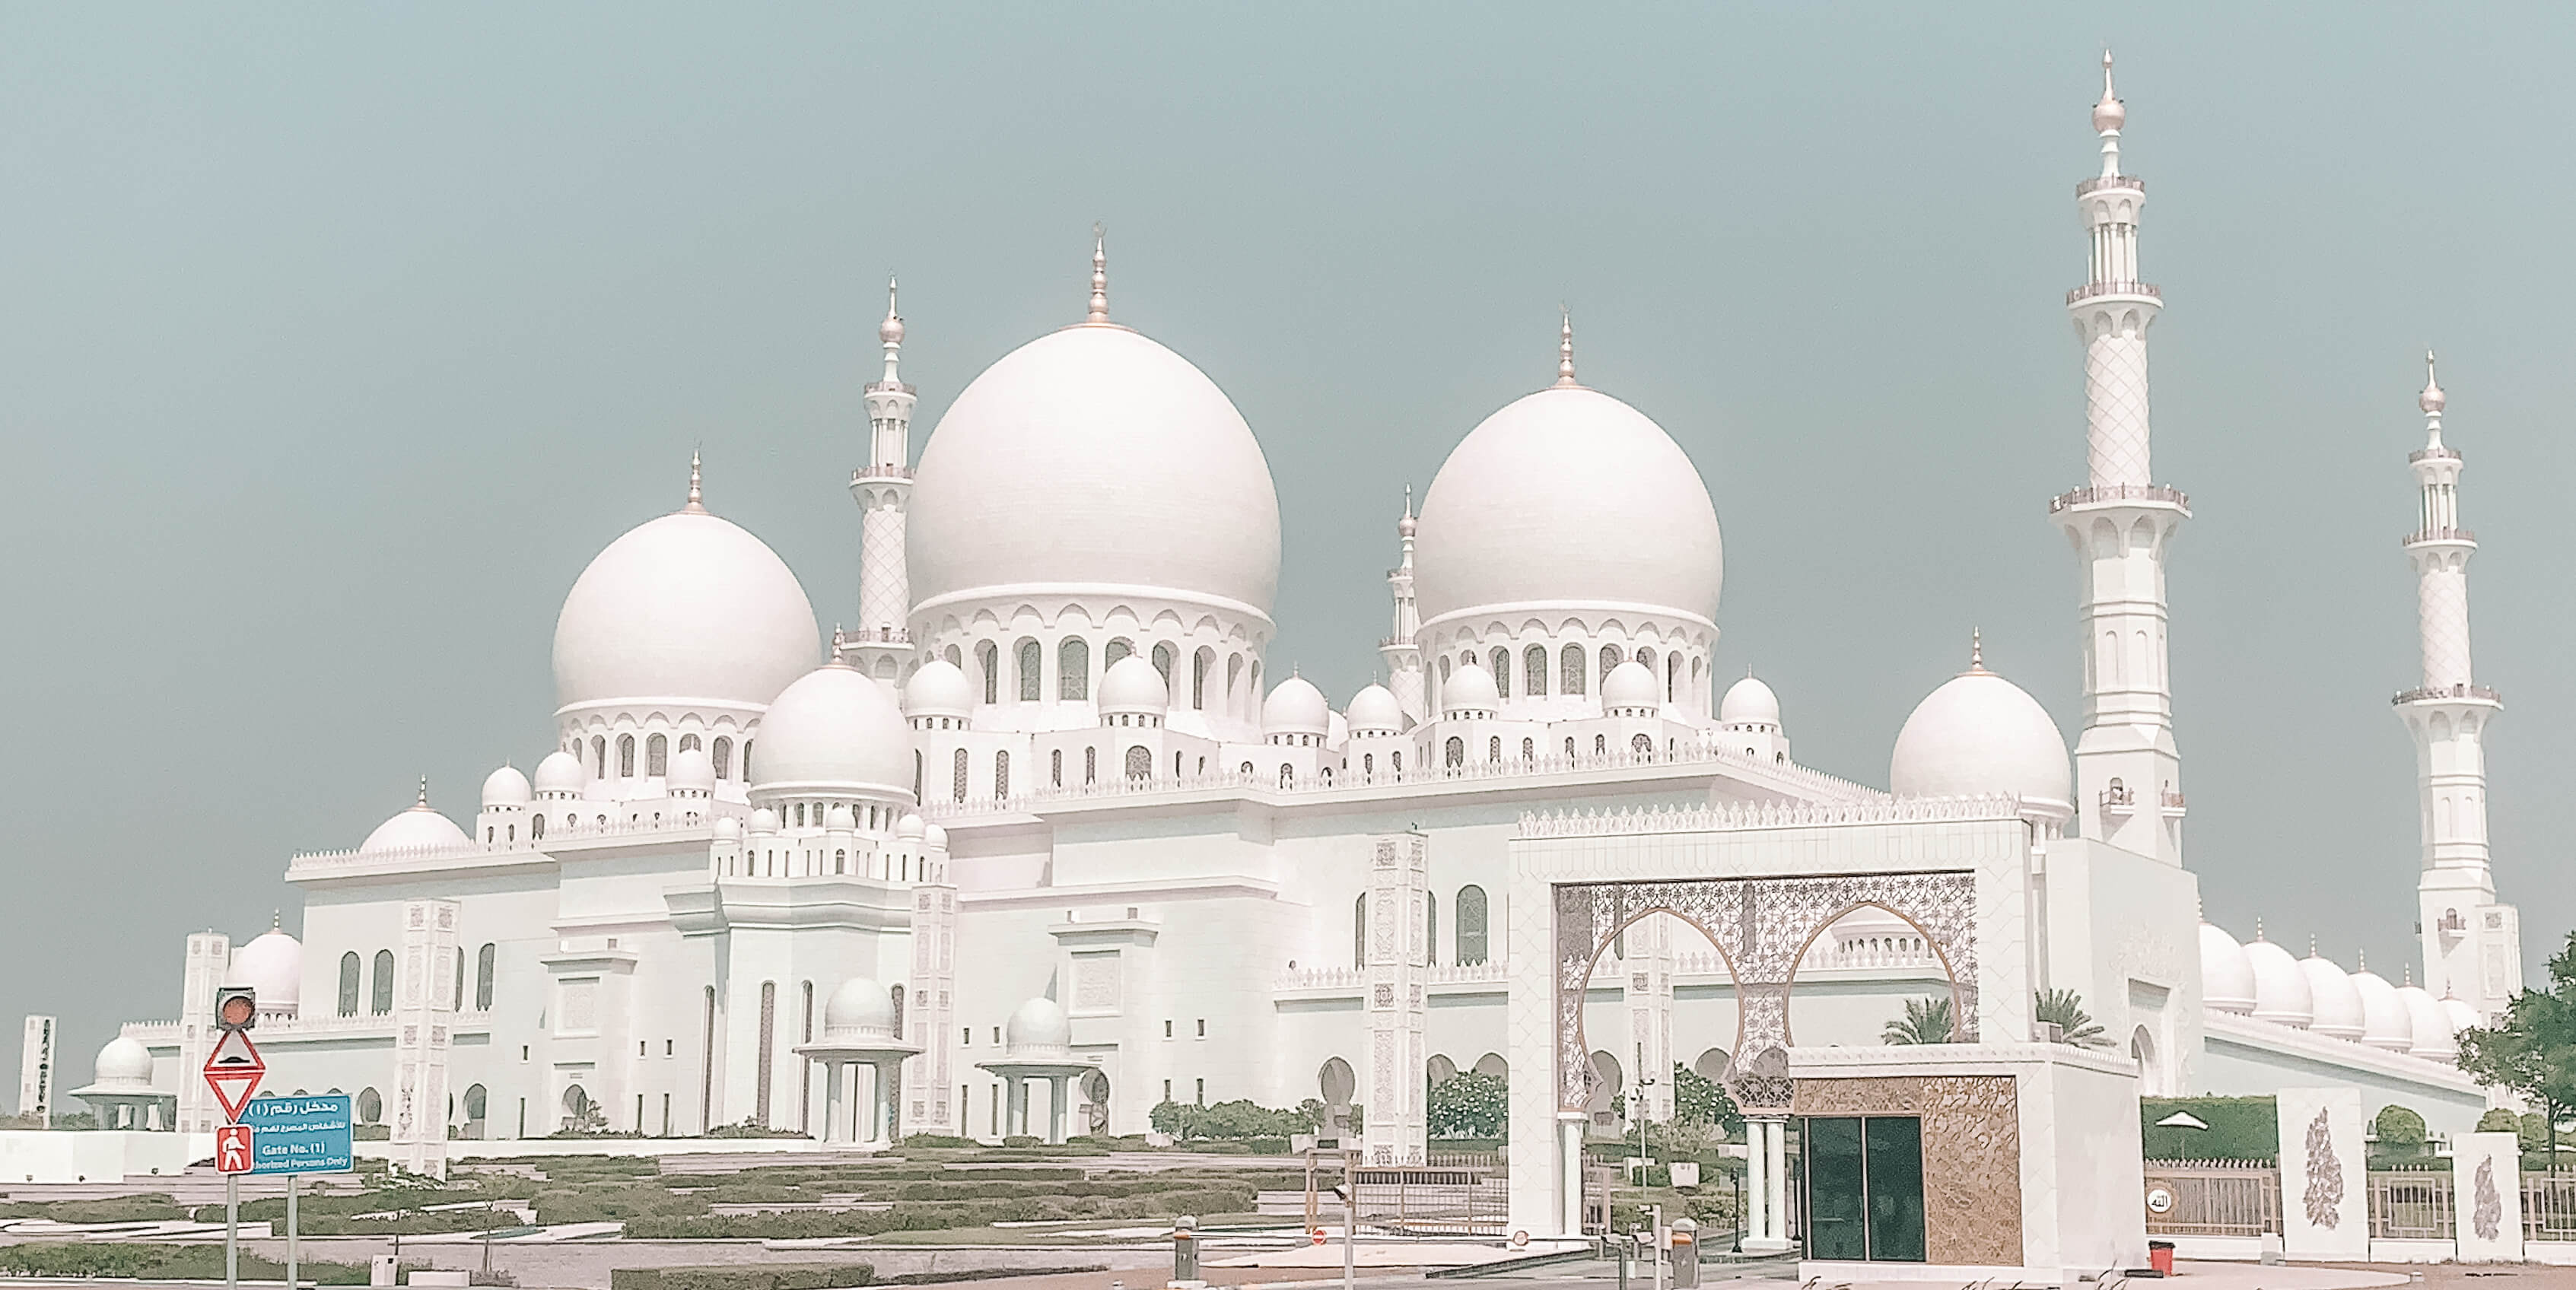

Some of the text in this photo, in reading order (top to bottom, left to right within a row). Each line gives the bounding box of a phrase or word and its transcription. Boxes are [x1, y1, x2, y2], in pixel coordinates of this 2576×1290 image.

[270, 1101, 298, 1116] رقم
[300, 1101, 339, 1114] مدخل
[262, 1142, 326, 1155] Gate No. (1)
[253, 1156, 348, 1170] horized Persons Only
